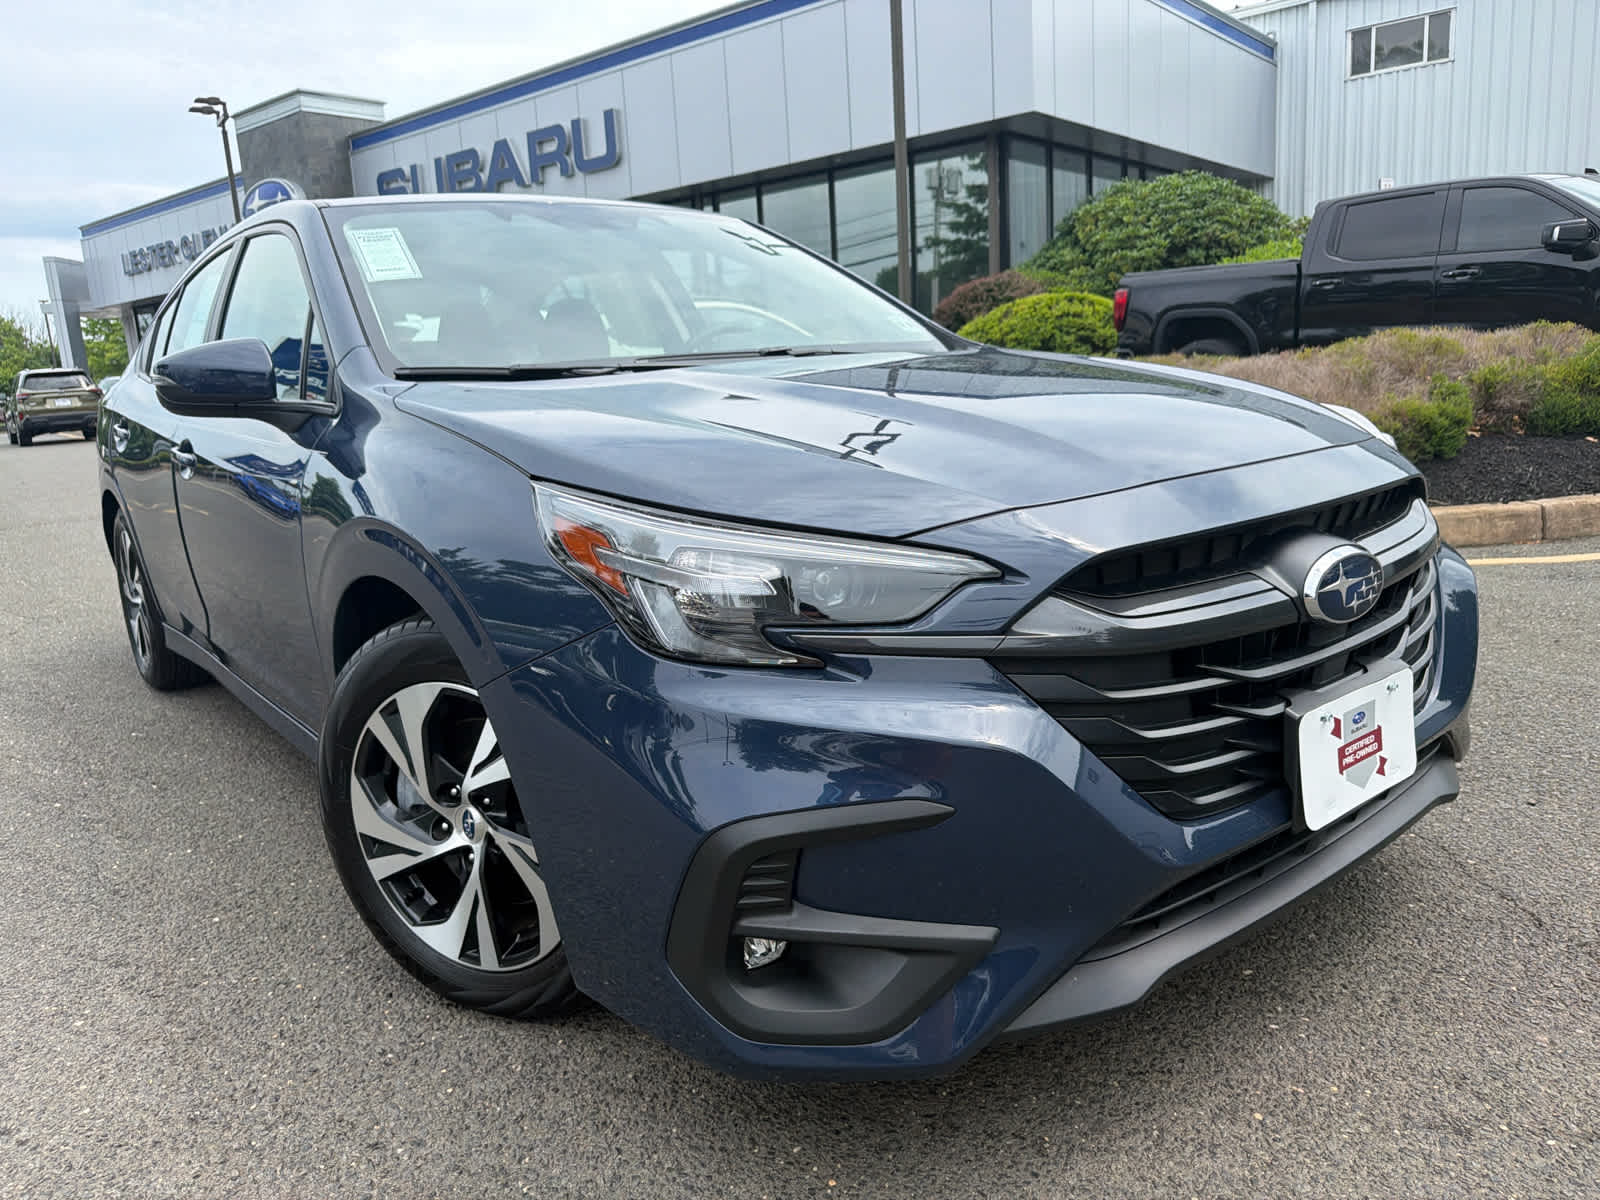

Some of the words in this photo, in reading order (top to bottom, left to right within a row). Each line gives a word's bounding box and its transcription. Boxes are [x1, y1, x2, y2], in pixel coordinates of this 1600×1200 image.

[376, 108, 620, 195] SUBARU
[121, 240, 178, 276] LESTER
[1342, 742, 1379, 767] PRE-OWNED
[1344, 734, 1375, 756] CERTIFIED
